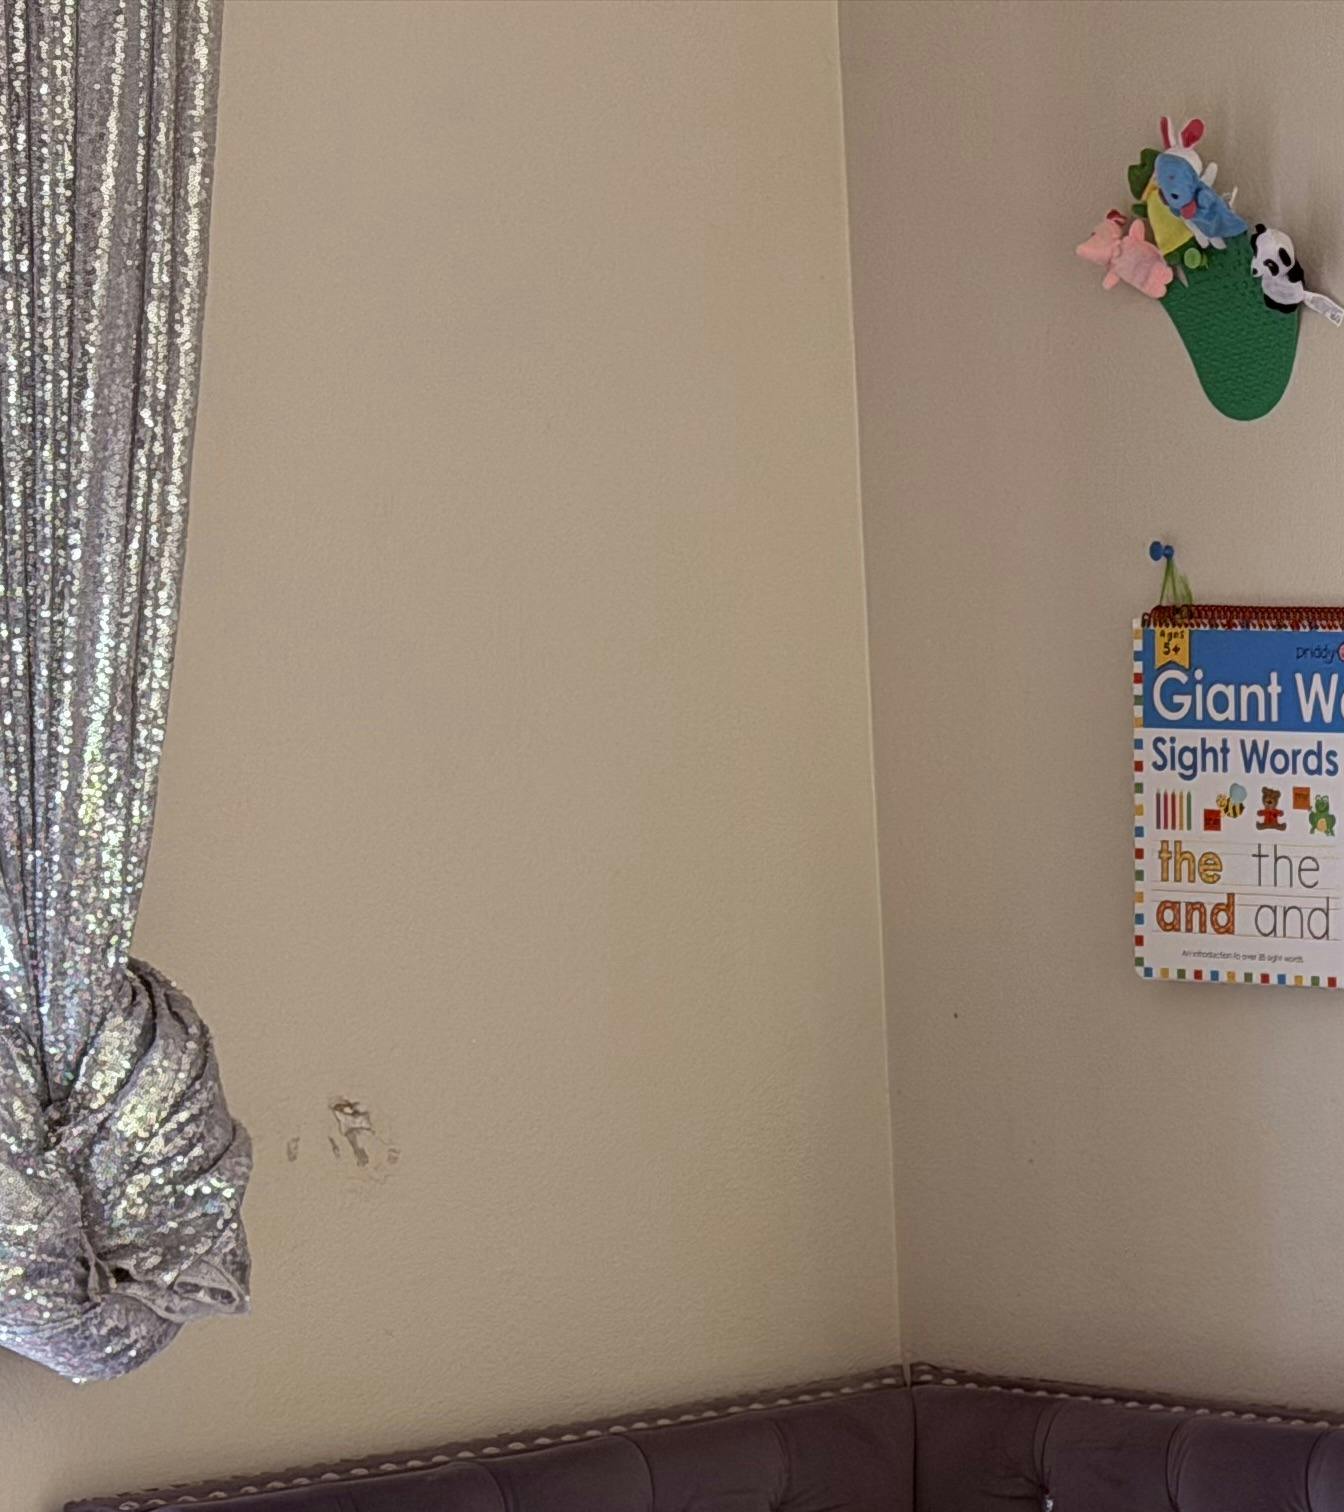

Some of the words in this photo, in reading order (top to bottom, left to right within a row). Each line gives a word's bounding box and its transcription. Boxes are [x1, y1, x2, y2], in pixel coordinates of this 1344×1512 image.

[1153, 668, 1283, 723] Giant
[1152, 736, 1230, 780] Sight
[1240, 738, 1340, 777] Words
[1158, 839, 1223, 884] the
[1252, 843, 1320, 889] the
[1156, 892, 1236, 936] and
[1254, 896, 1330, 941] and
